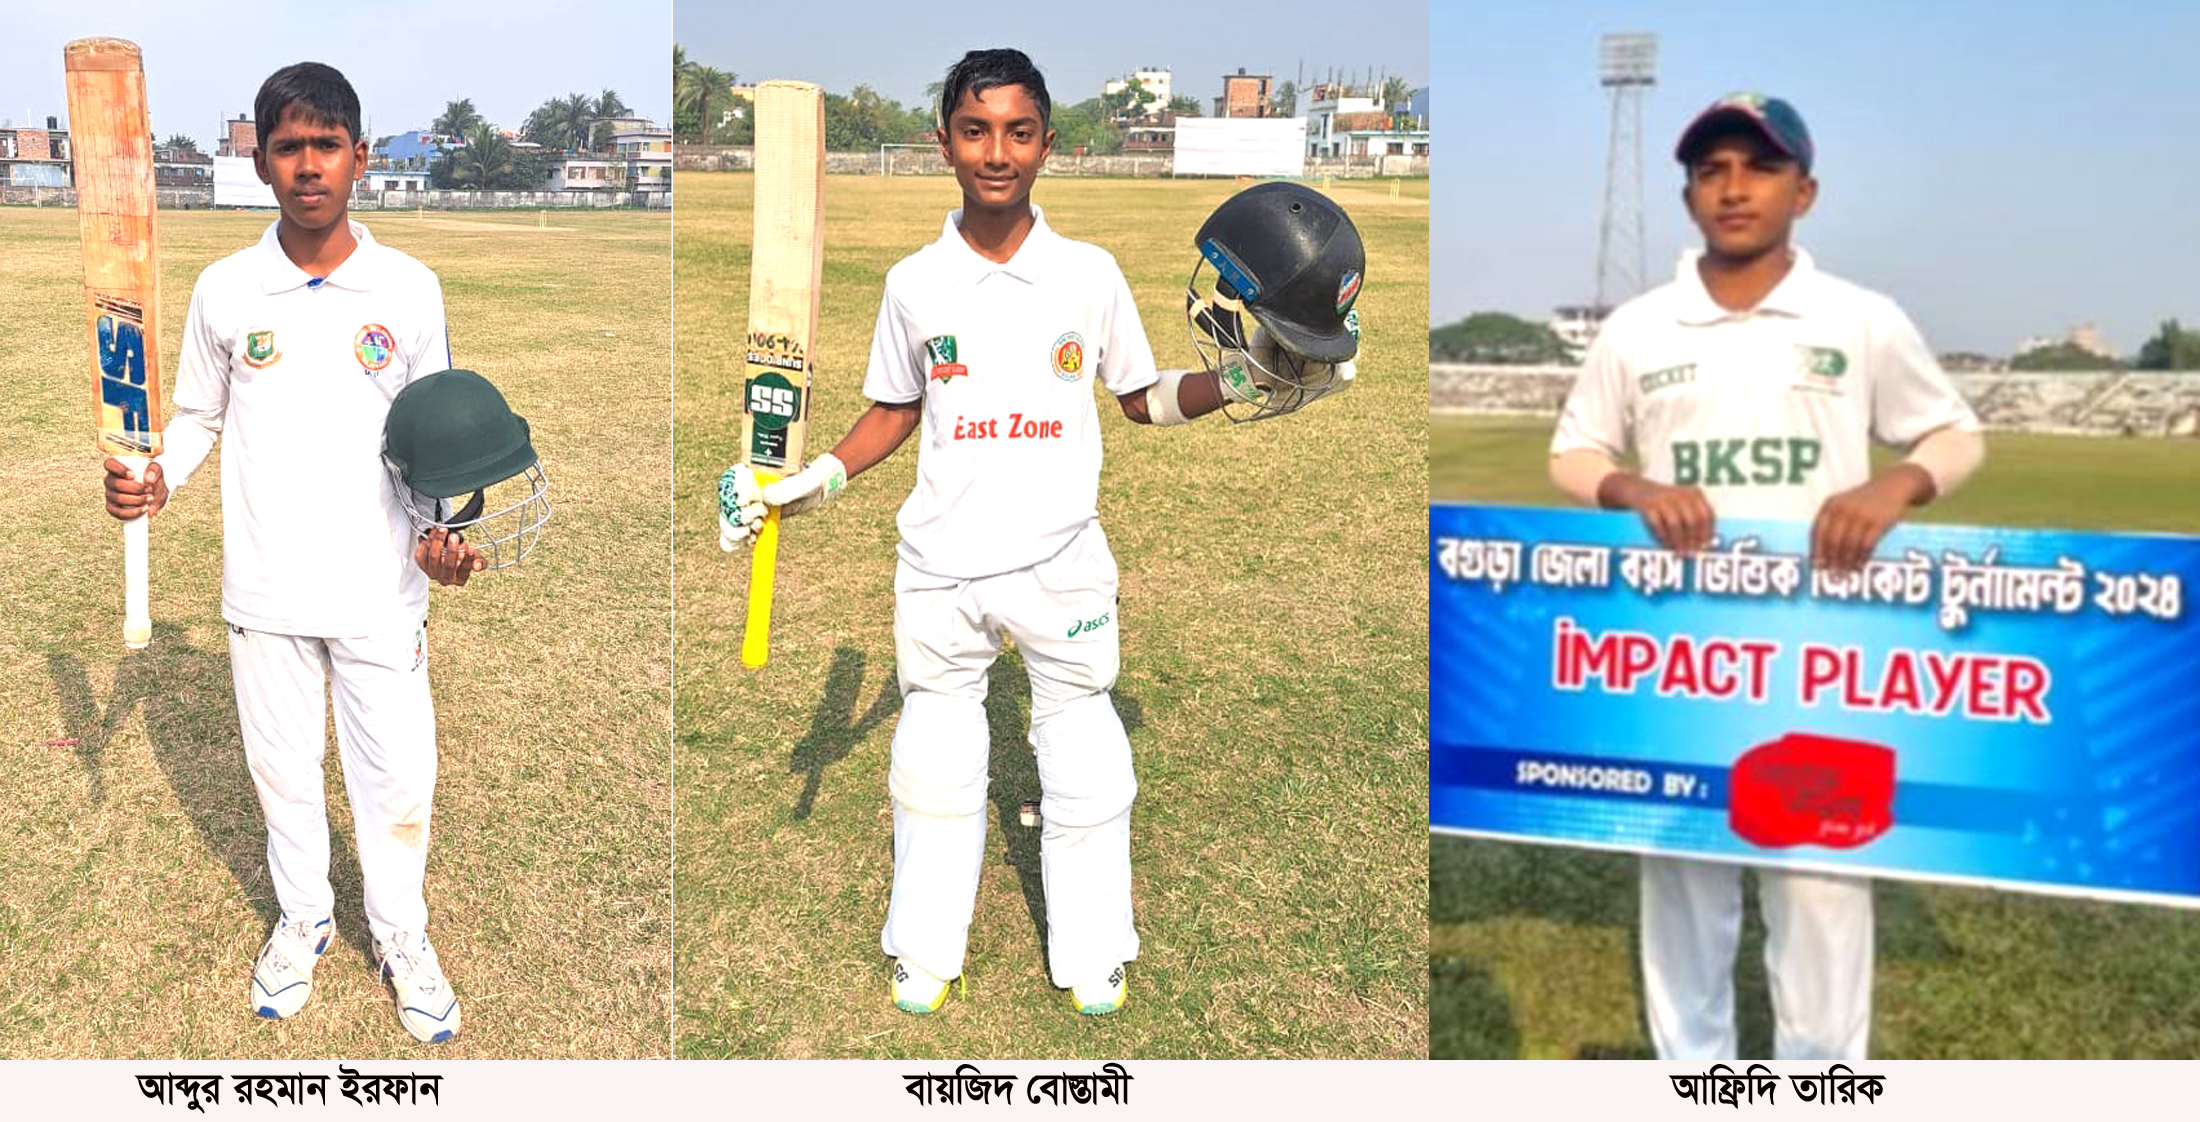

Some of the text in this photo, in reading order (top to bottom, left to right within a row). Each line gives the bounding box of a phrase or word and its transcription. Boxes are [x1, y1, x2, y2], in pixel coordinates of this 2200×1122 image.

[97, 314, 151, 445] SF
[750, 384, 794, 417] SS
[954, 413, 1063, 440] East Zone
[1671, 437, 1821, 486] BKSP
[1436, 538, 1521, 593] বগুড়া
[1532, 543, 1609, 587] জেলা
[2094, 572, 2181, 620] ২০২৪
[1800, 645, 2048, 721] PLAYER
[1516, 760, 1652, 794] SPONSORED
